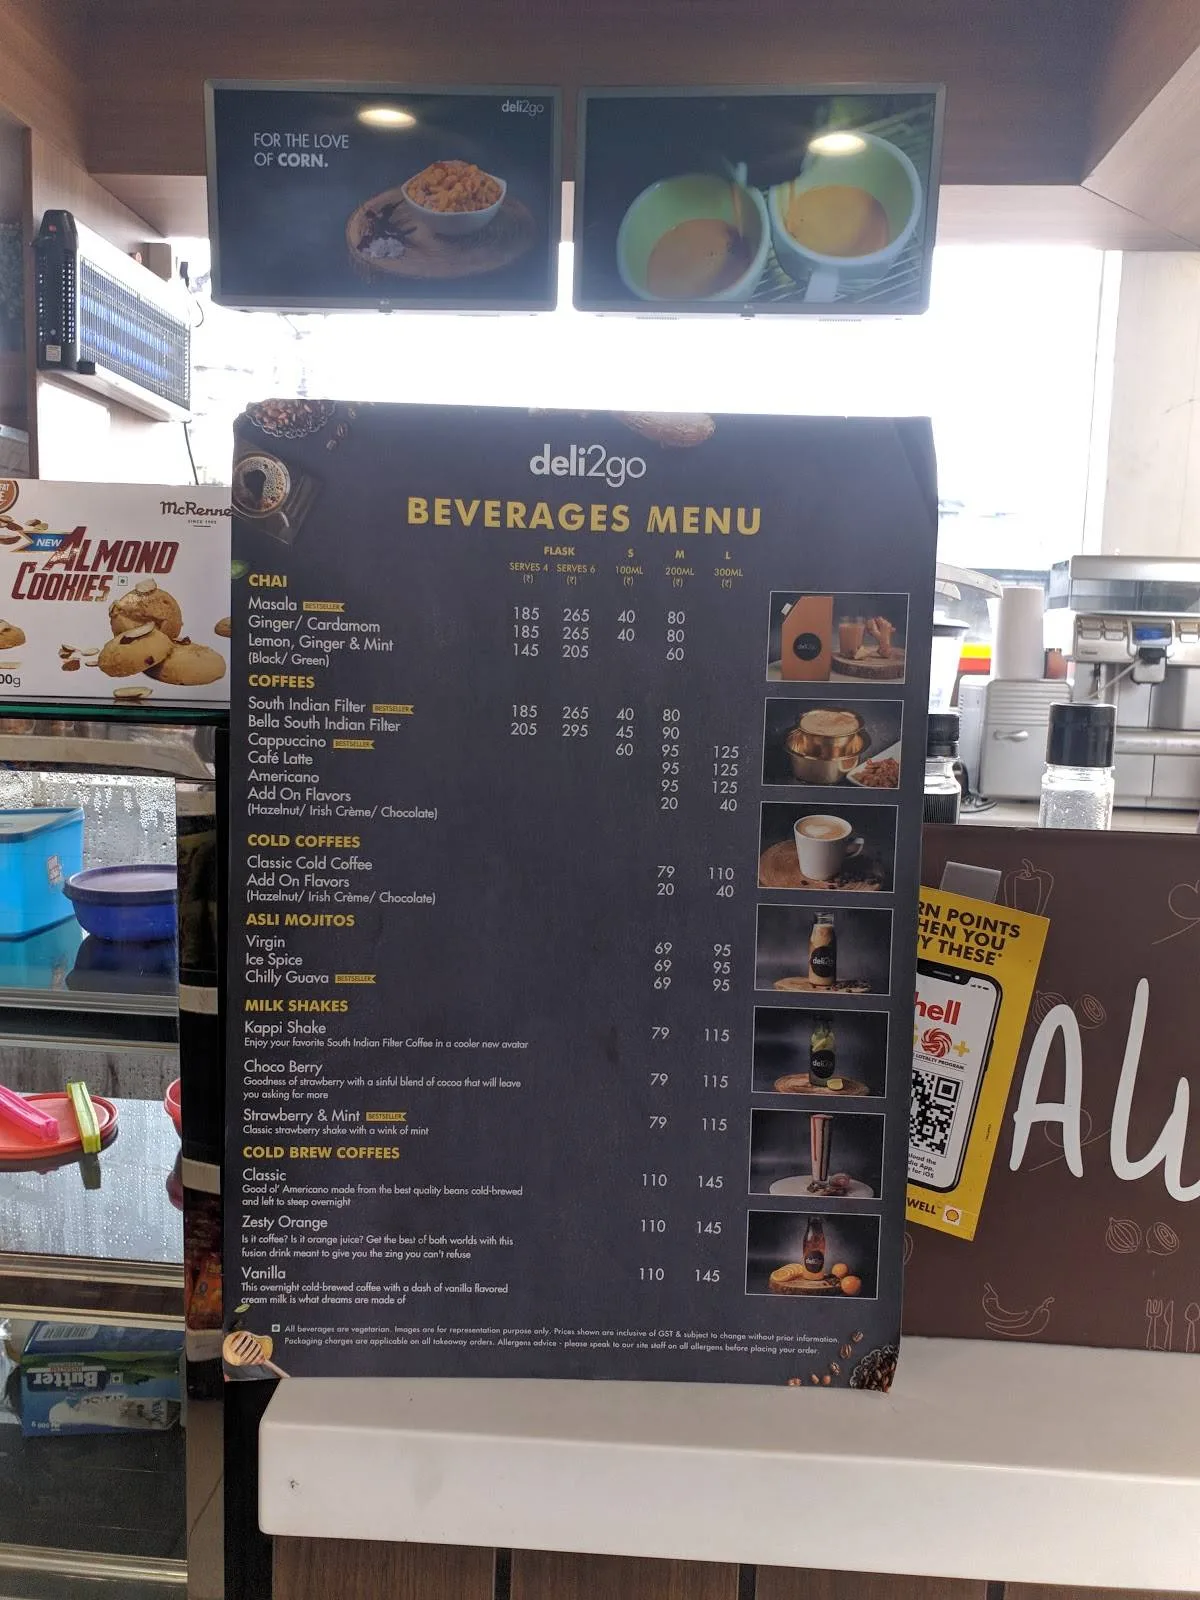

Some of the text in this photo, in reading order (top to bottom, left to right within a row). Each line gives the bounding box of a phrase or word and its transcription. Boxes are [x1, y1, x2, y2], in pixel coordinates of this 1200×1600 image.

[502, 100, 544, 117] deli2go
[254, 133, 350, 150] FOR THE LOVE
[254, 152, 330, 168] OF CORN.
[529, 443, 647, 488] deli2go
[408, 496, 761, 536] BEVERAGES MENU
[36, 537, 62, 548] NEW
[42, 526, 180, 574] ALMOND
[543, 546, 731, 560] FLASK S M L
[509, 561, 744, 577] SERVES 4 SERVES 6 100ML 200ML 300ML
[11, 561, 114, 602] COOKIES
[248, 573, 287, 588] CHAI
[248, 595, 298, 611] Masala
[248, 614, 381, 633] Ginger/ Cardamom
[514, 606, 686, 625] 185 265 40 80
[248, 632, 394, 653] Lemon, Ginger & Mint
[248, 650, 330, 668] (Black/ Green)
[513, 643, 685, 661] 145 205 60
[248, 674, 315, 689] COFFEES
[248, 695, 285, 710] South
[289, 696, 330, 712] Indian
[334, 697, 367, 713] Filter
[247, 732, 327, 750] Cappuccino
[247, 748, 313, 766] Café Latte
[615, 743, 739, 759] 60 95 125
[247, 768, 320, 784] Americano
[247, 785, 352, 802] Add On Flavors
[247, 802, 438, 821] (Hazelnut/ Irish Crème/ Chocolate)
[660, 796, 738, 812] 20 40
[247, 833, 361, 849] COLD COFFEES
[246, 853, 373, 871] Classic Cold Coffee
[246, 913, 355, 927] ASLI MOJITOS
[946, 908, 1021, 938] POINTS
[245, 934, 286, 952] Virgin
[918, 934, 933, 950] Y
[963, 928, 1006, 951] YOU
[246, 952, 303, 969] Ice Spice
[245, 968, 282, 987] Chilly
[285, 970, 329, 984] Guava
[653, 976, 730, 992] 69 95
[245, 999, 349, 1013] MILK SHAKES
[244, 1019, 327, 1037] Kappi Shake
[244, 1037, 269, 1049] Enjoy
[270, 1039, 291, 1049] your
[292, 1036, 325, 1047] favorite
[326, 1036, 351, 1047] South
[353, 1036, 380, 1048] Indian
[382, 1037, 404, 1048] Filter
[405, 1036, 434, 1048] Coffee
[435, 1038, 444, 1048] in
[453, 1037, 480, 1049] cooler
[481, 1041, 500, 1049] new
[501, 1040, 529, 1049] avatar
[243, 1058, 323, 1076] Choco Berry
[243, 1106, 314, 1125] Strawberry
[317, 1108, 328, 1122] &
[331, 1108, 361, 1122] Mint
[649, 1116, 727, 1131] 79 115
[242, 1124, 273, 1134] Classic
[274, 1124, 321, 1137] strawberry
[322, 1124, 348, 1135] shake
[348, 1124, 367, 1135] with
[377, 1124, 398, 1135] wink
[399, 1124, 409, 1136] of
[410, 1126, 429, 1136] mint
[243, 1146, 400, 1159] COLD BREW COFFEES
[242, 1166, 287, 1182] Classic
[906, 1197, 937, 1215] WELL
[241, 1215, 329, 1232] Zesty Orange
[241, 1247, 472, 1261] fusion drink meant to give you the zing you can't refuse
[241, 1264, 286, 1280] Vanilla
[33, 1371, 98, 1388] Butter
